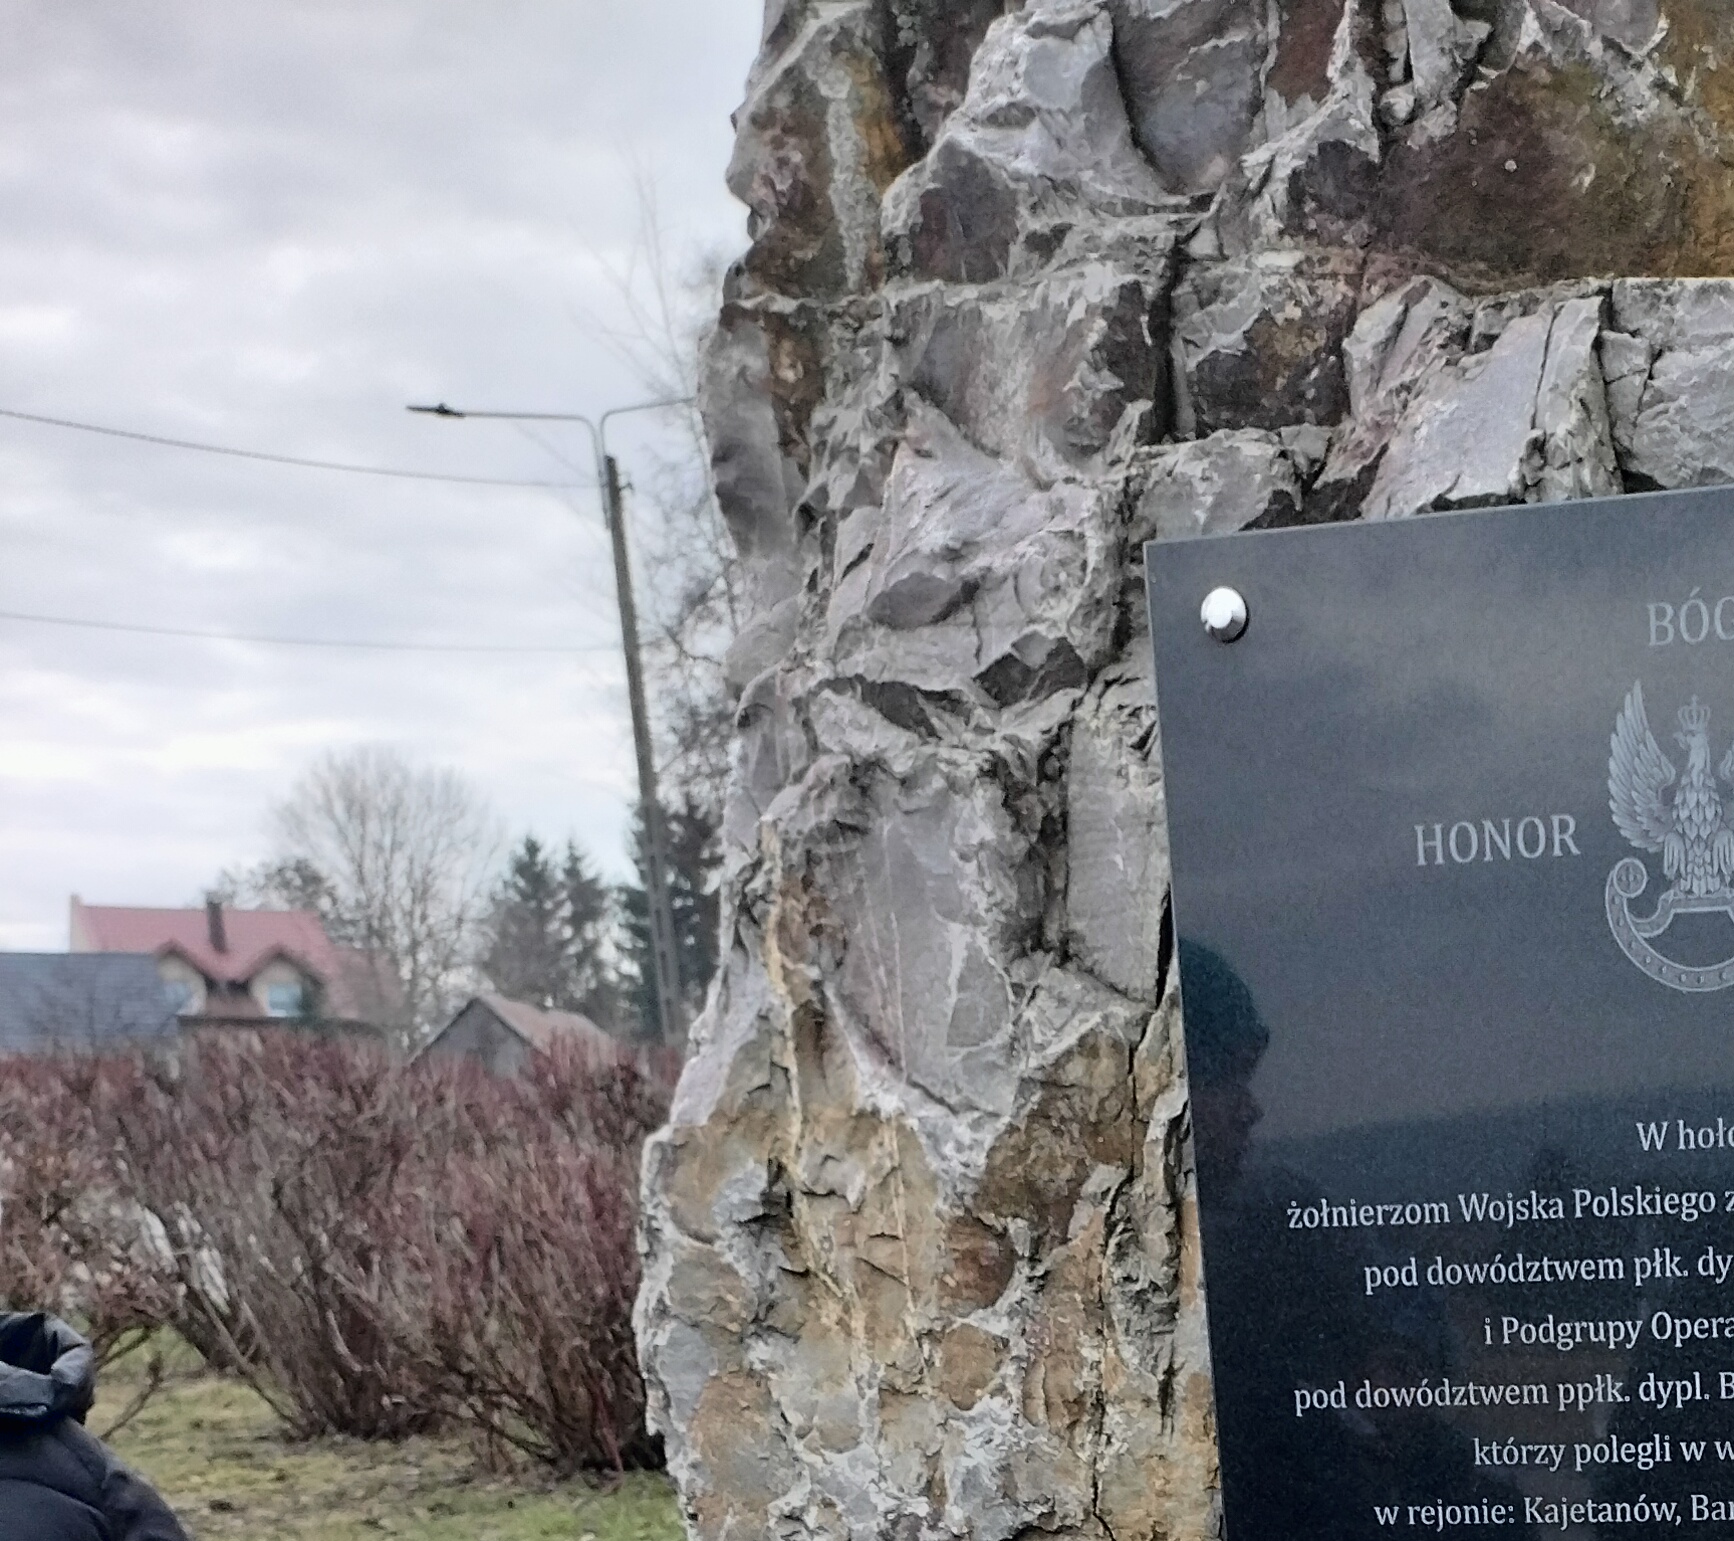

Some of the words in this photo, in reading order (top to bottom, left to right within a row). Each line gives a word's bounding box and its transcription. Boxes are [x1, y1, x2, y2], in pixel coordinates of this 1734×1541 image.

[1414, 814, 1581, 866] HONOR
[1635, 1121, 1669, 1151] W
[1286, 1198, 1451, 1229] żołnierzom
[1457, 1190, 1565, 1228] Wojska
[1572, 1185, 1716, 1222] Polskiego
[1364, 1256, 1419, 1296] pod
[1426, 1252, 1625, 1285] dowództwem
[1633, 1247, 1689, 1287] płk.
[1484, 1317, 1493, 1345] i
[1501, 1313, 1643, 1351] Podgrupy
[1294, 1380, 1347, 1418] pod
[1355, 1377, 1549, 1409] dowództwem
[1557, 1373, 1631, 1412] ppłk.
[1638, 1371, 1710, 1410] dypl.
[1473, 1436, 1566, 1472] którzy
[1573, 1433, 1672, 1472] polegli
[1679, 1441, 1707, 1462] w
[1373, 1505, 1400, 1526] w
[1407, 1497, 1515, 1532] rejonie:
[1524, 1493, 1682, 1531] Kajetanów,
